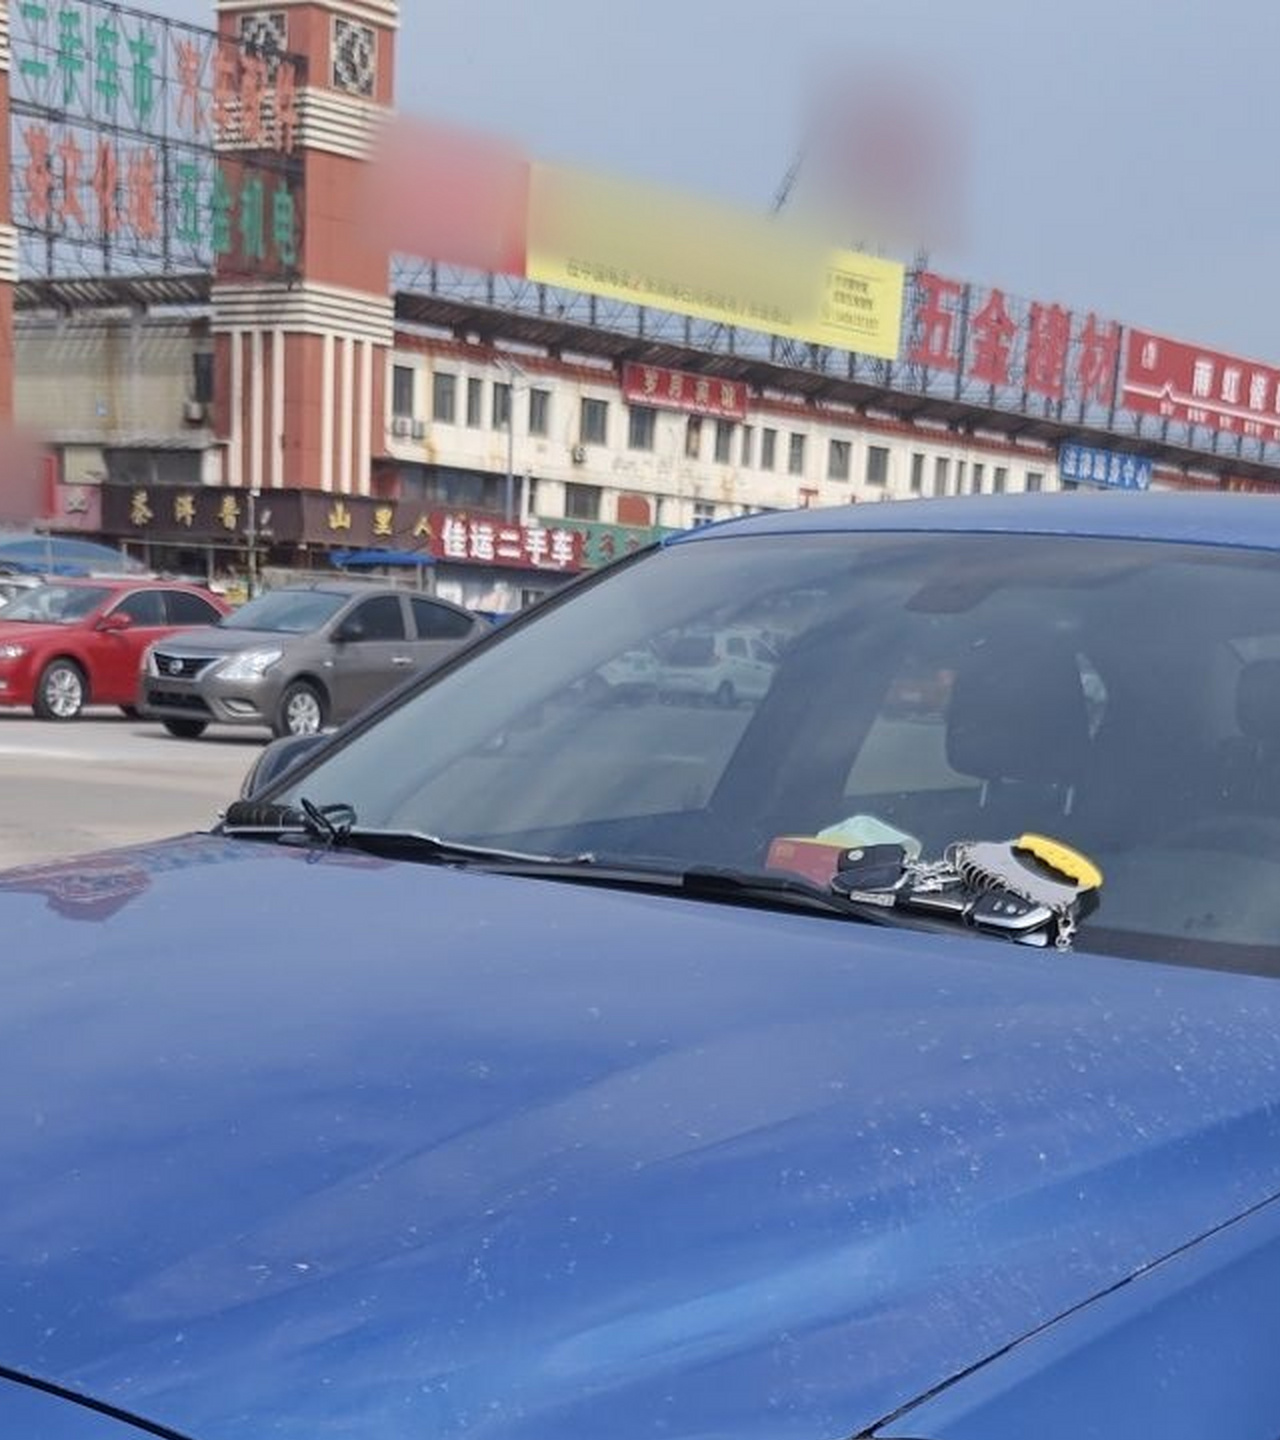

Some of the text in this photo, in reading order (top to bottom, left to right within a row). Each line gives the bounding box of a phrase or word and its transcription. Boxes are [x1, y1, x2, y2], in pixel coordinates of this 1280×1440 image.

[911, 270, 1120, 410] 五金建材
[1063, 449, 1148, 491] 法律服务中心
[441, 515, 575, 568] 佳运二手车
